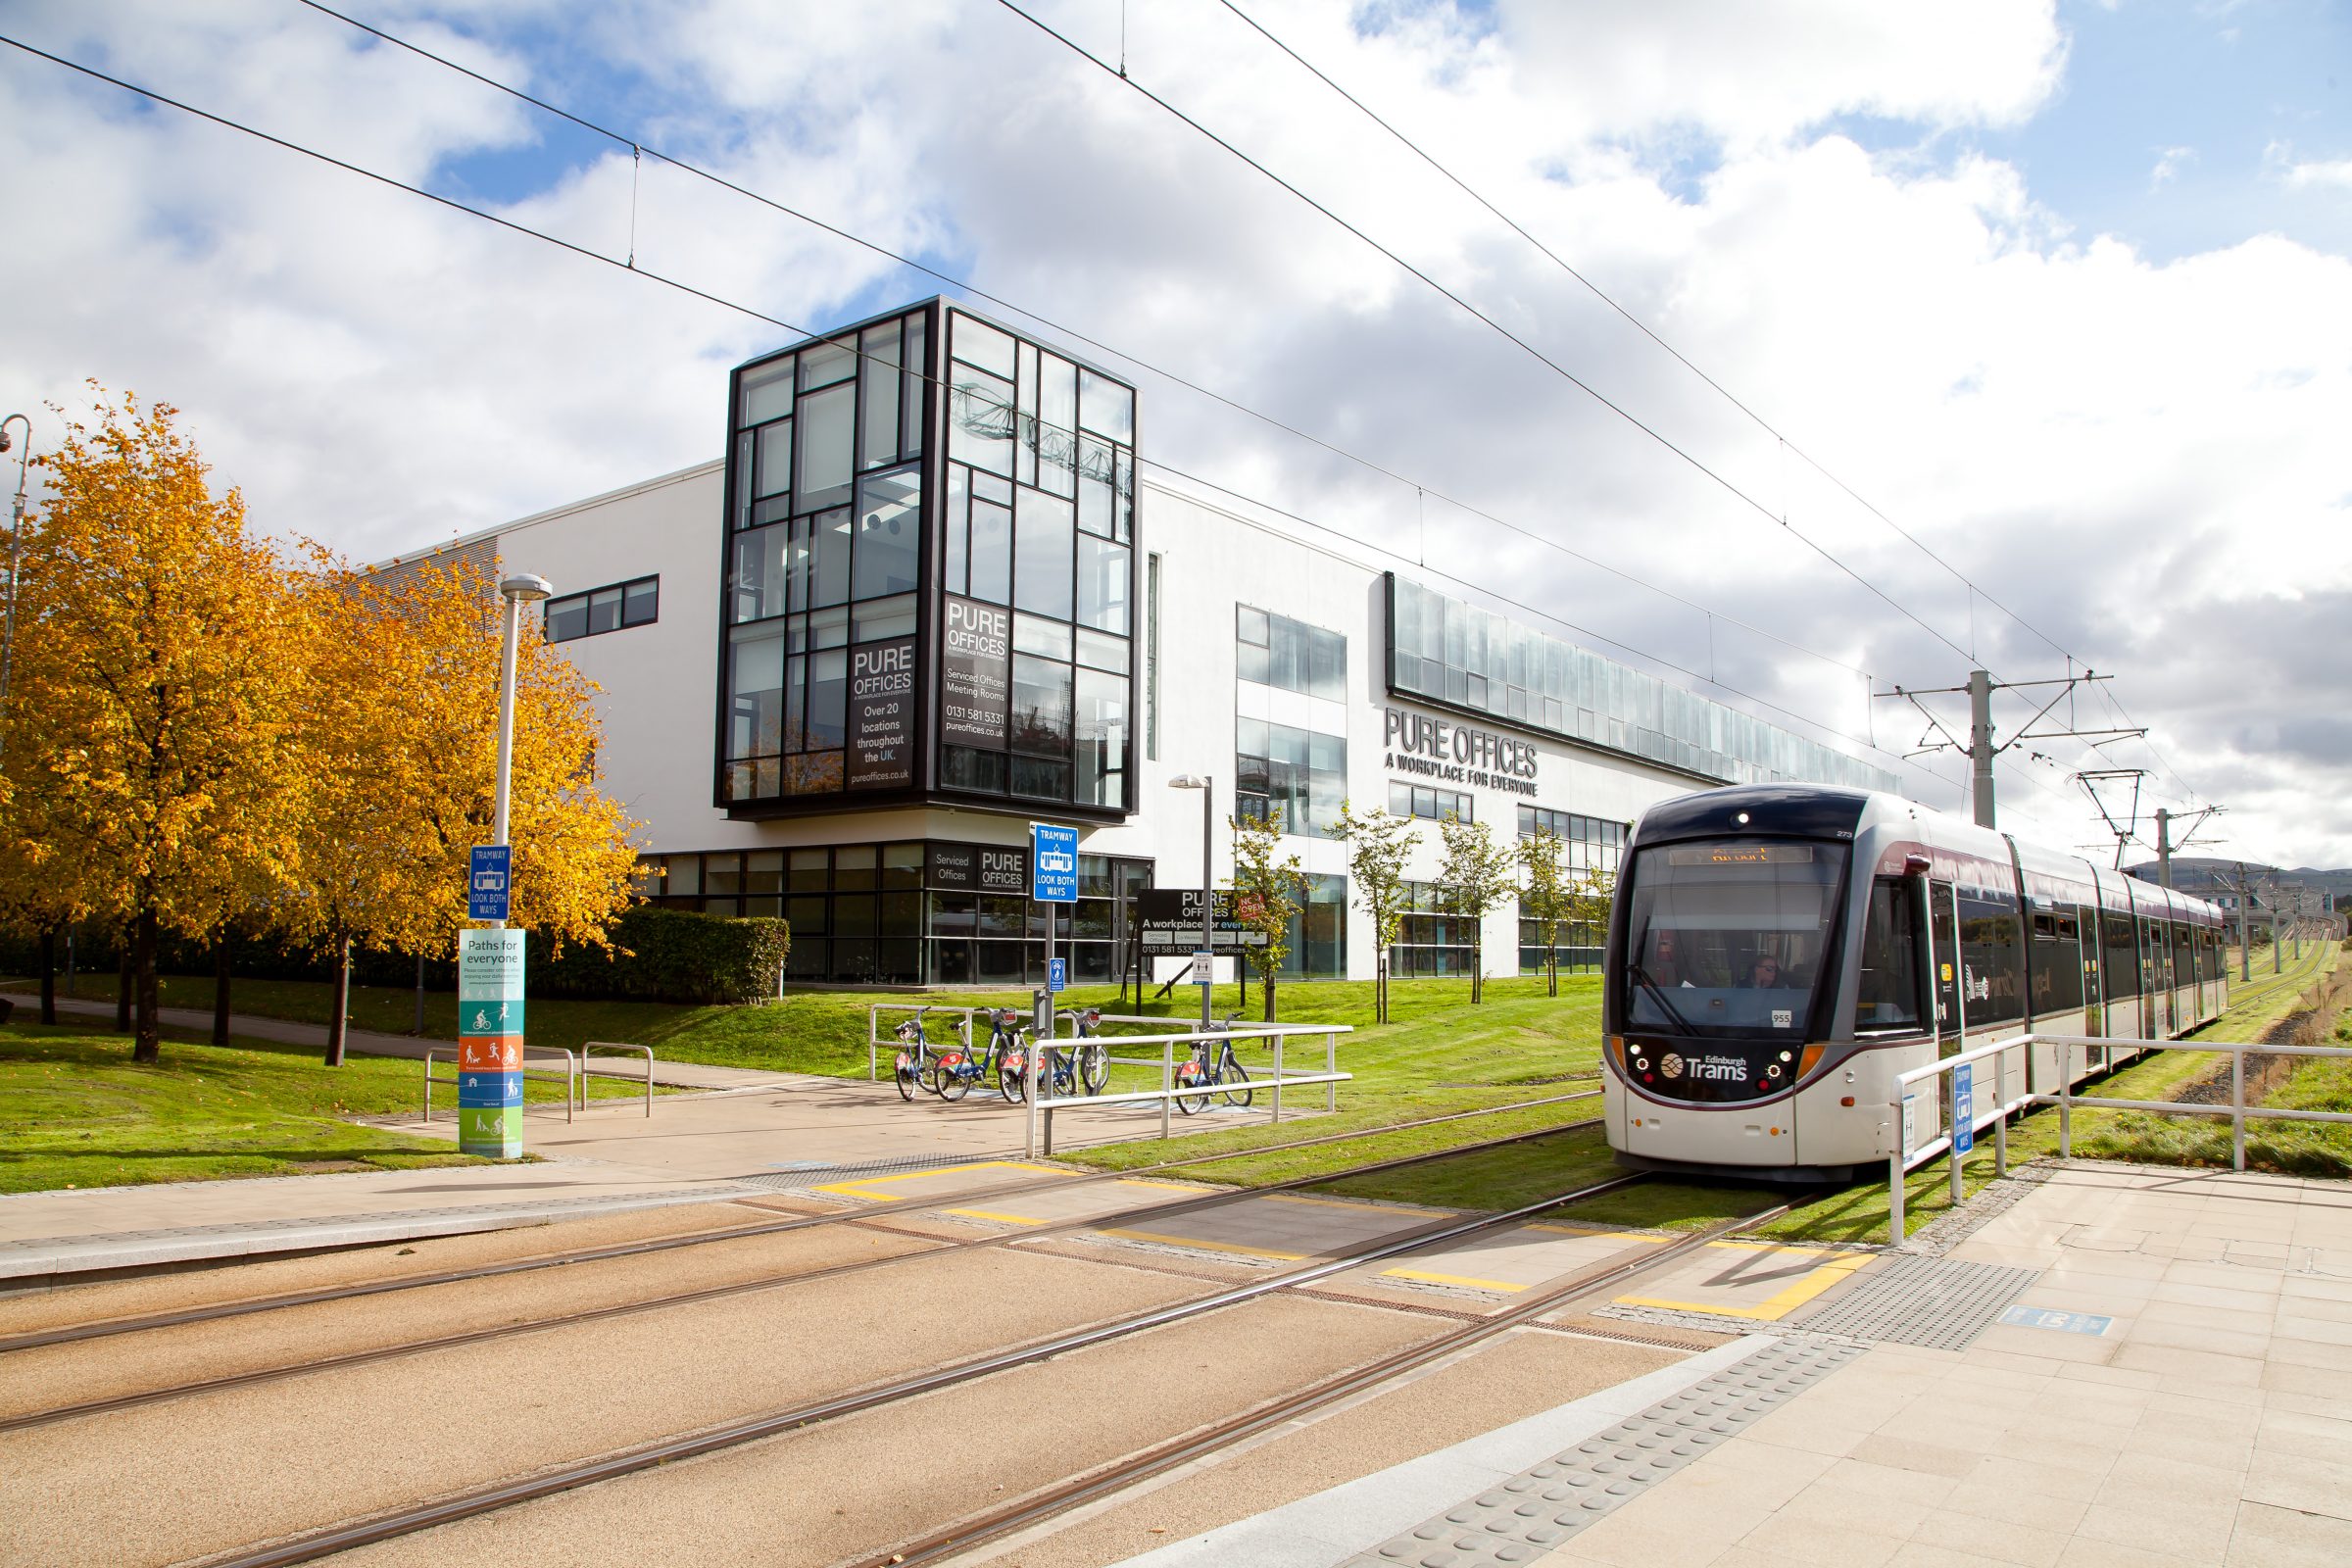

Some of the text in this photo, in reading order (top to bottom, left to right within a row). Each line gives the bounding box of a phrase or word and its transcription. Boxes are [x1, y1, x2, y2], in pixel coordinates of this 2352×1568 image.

[949, 602, 1005, 638] PURE
[949, 629, 1005, 656] OFFICES
[855, 645, 912, 676] PURE
[854, 672, 911, 694] OFFICES
[947, 668, 1004, 688] Serviced Offices
[947, 681, 1004, 702] Meeting Rooms
[864, 703, 899, 717] Over 20
[946, 705, 1004, 724] 0131 581 5331
[861, 720, 901, 733] locations
[946, 722, 1004, 738] pureoffices.co.uk
[857, 734, 905, 749] throughout
[1383, 708, 1538, 779] PURE OFFICES
[864, 749, 896, 763] the UK.
[851, 769, 909, 784] pureoffices.co.uk
[1384, 753, 1539, 798] A WORKPLACE FOR EVERYONE
[1040, 829, 1073, 842] TRAMWAY
[475, 851, 507, 860] TRAMWAY
[936, 854, 969, 866] Serviced
[982, 853, 1023, 872] PURE
[938, 868, 966, 881] Offices
[982, 871, 1023, 885] OFFICES
[1037, 874, 1075, 886] LOOK BOTH
[471, 893, 507, 904] LOOK BOTH
[1047, 887, 1066, 897] WAYS
[479, 905, 497, 915] WAYS
[1143, 918, 1151, 928] A
[1152, 918, 1203, 931] workplace
[468, 940, 517, 951] Paths for
[1142, 945, 1159, 954] 0131
[1161, 945, 1175, 954] 581
[467, 955, 518, 965] everyone
[1773, 1014, 1790, 1023] 955
[1705, 1055, 1746, 1066] Edinburgh
[1686, 1057, 1747, 1081] Trams
